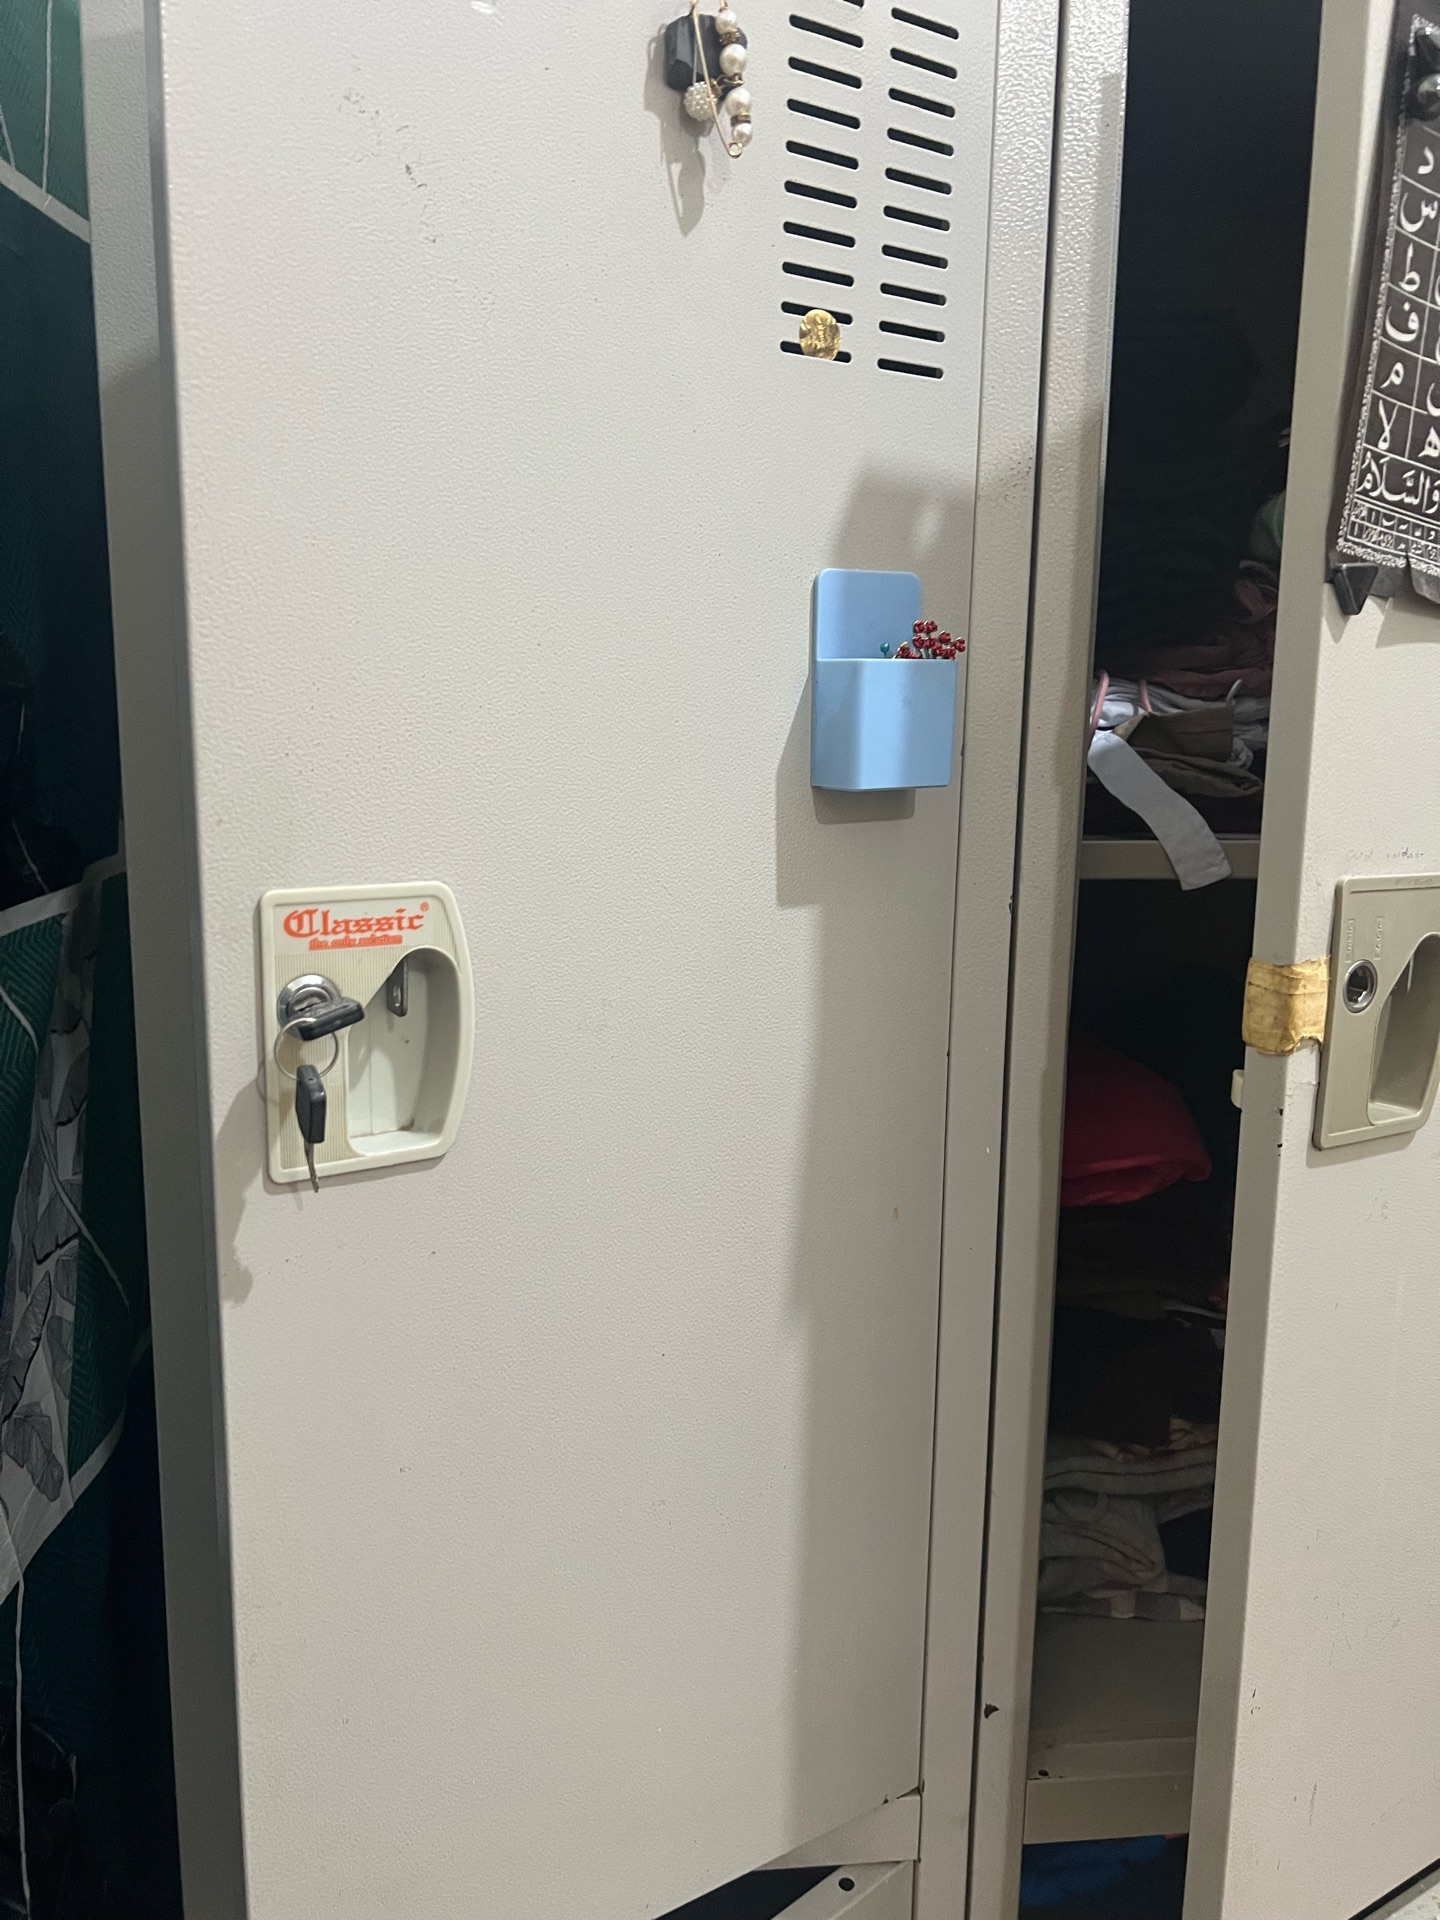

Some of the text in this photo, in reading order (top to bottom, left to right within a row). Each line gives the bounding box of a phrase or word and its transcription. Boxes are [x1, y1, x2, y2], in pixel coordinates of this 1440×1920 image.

[1401, 192, 1438, 233] س
[1398, 242, 1421, 292] ط
[1385, 302, 1420, 342] ف
[1380, 362, 1404, 388] م
